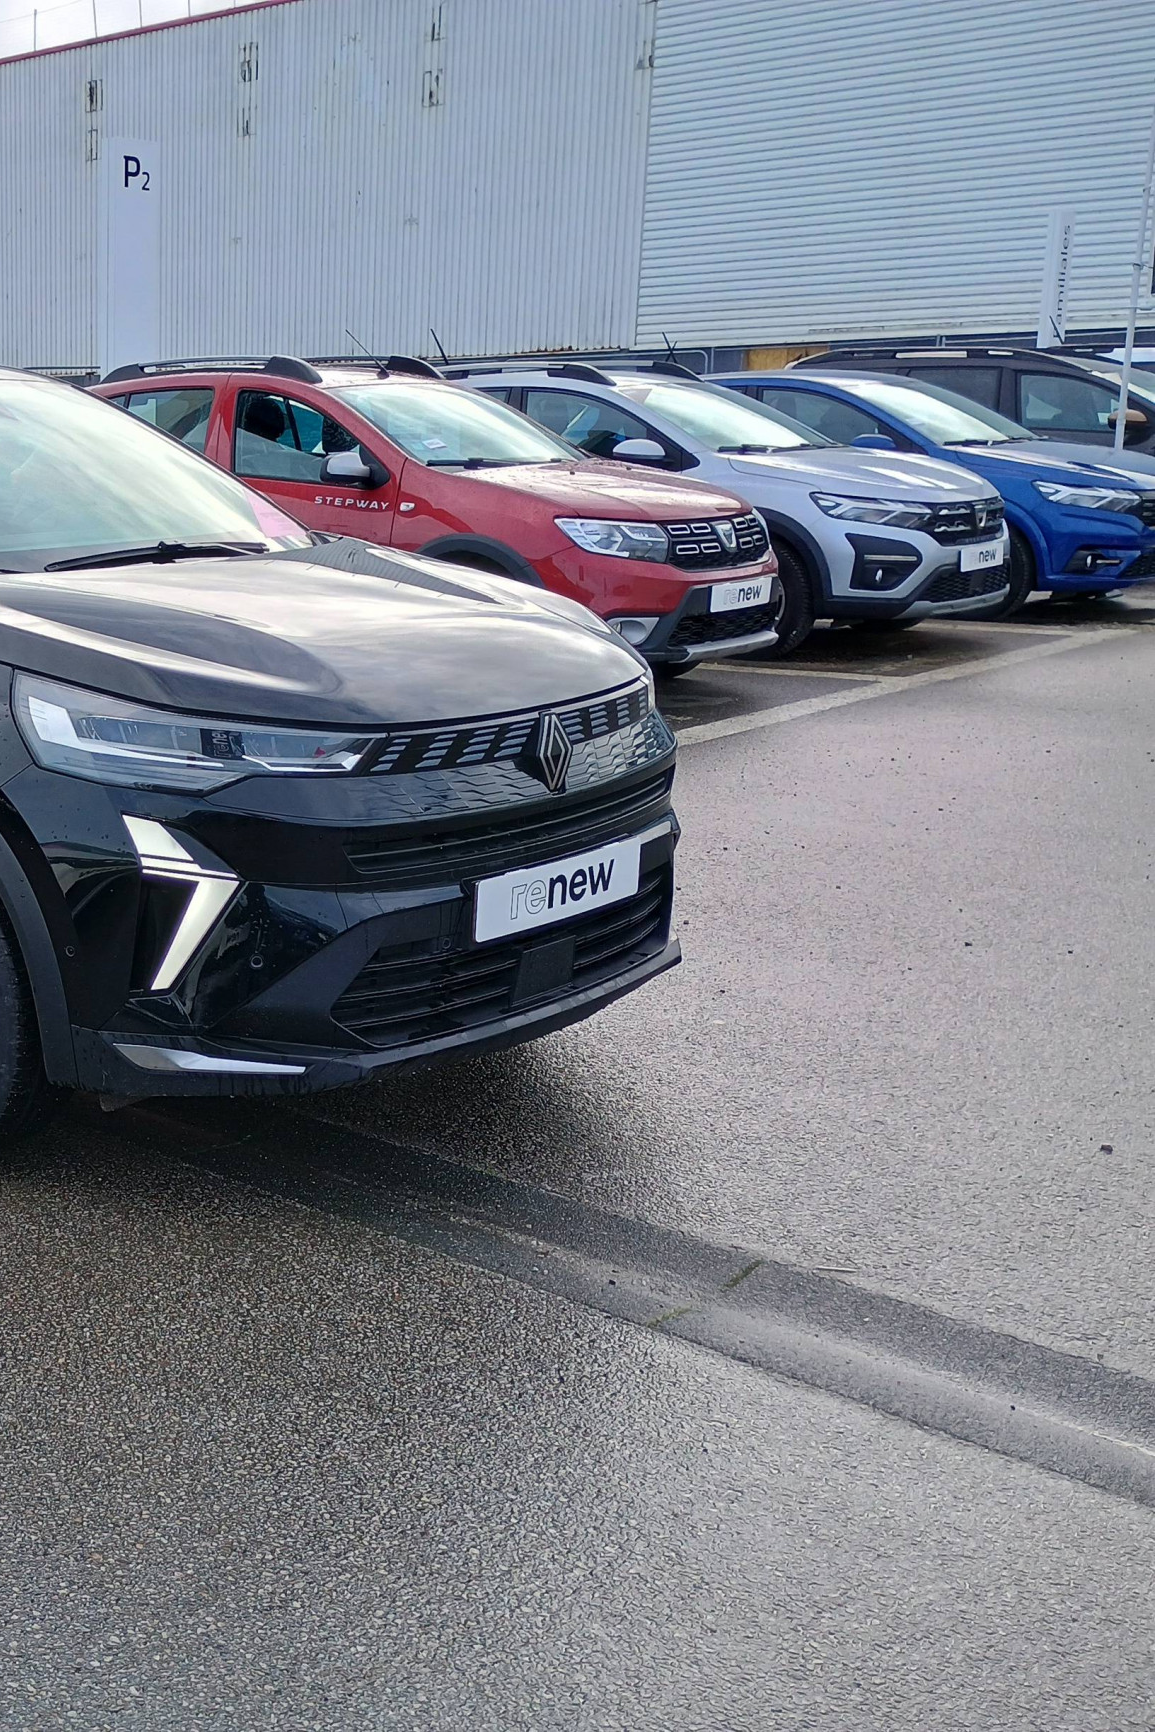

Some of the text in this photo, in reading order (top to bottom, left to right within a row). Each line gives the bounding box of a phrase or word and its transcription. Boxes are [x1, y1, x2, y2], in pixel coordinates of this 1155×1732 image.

[314, 496, 389, 510] STEPWAY
[723, 584, 763, 605] renew
[510, 858, 615, 921] renew
